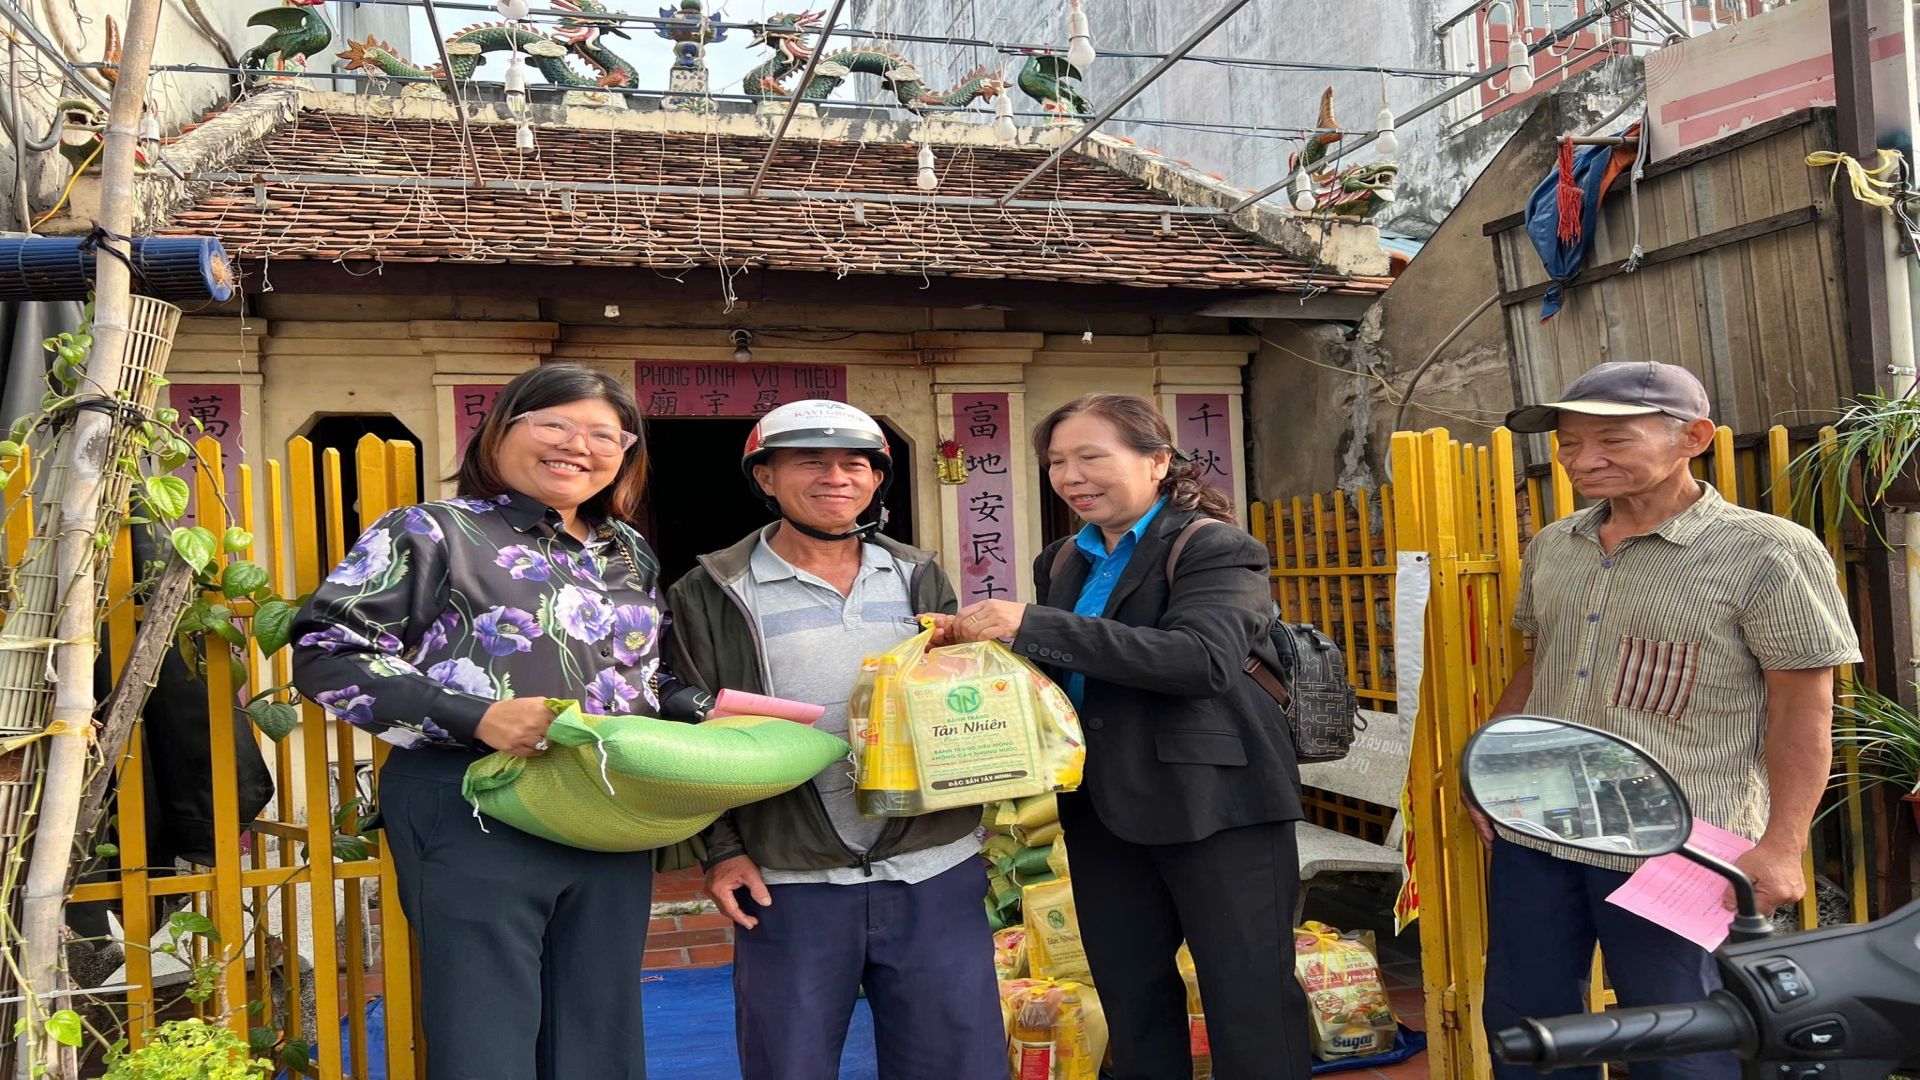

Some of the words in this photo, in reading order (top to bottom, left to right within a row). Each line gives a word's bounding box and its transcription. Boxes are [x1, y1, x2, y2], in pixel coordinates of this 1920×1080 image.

[641, 365, 690, 386] PHONG
[932, 724, 958, 737] Tân
[963, 719, 1008, 734] Nhiên
[1332, 1032, 1375, 1049] Sugar
